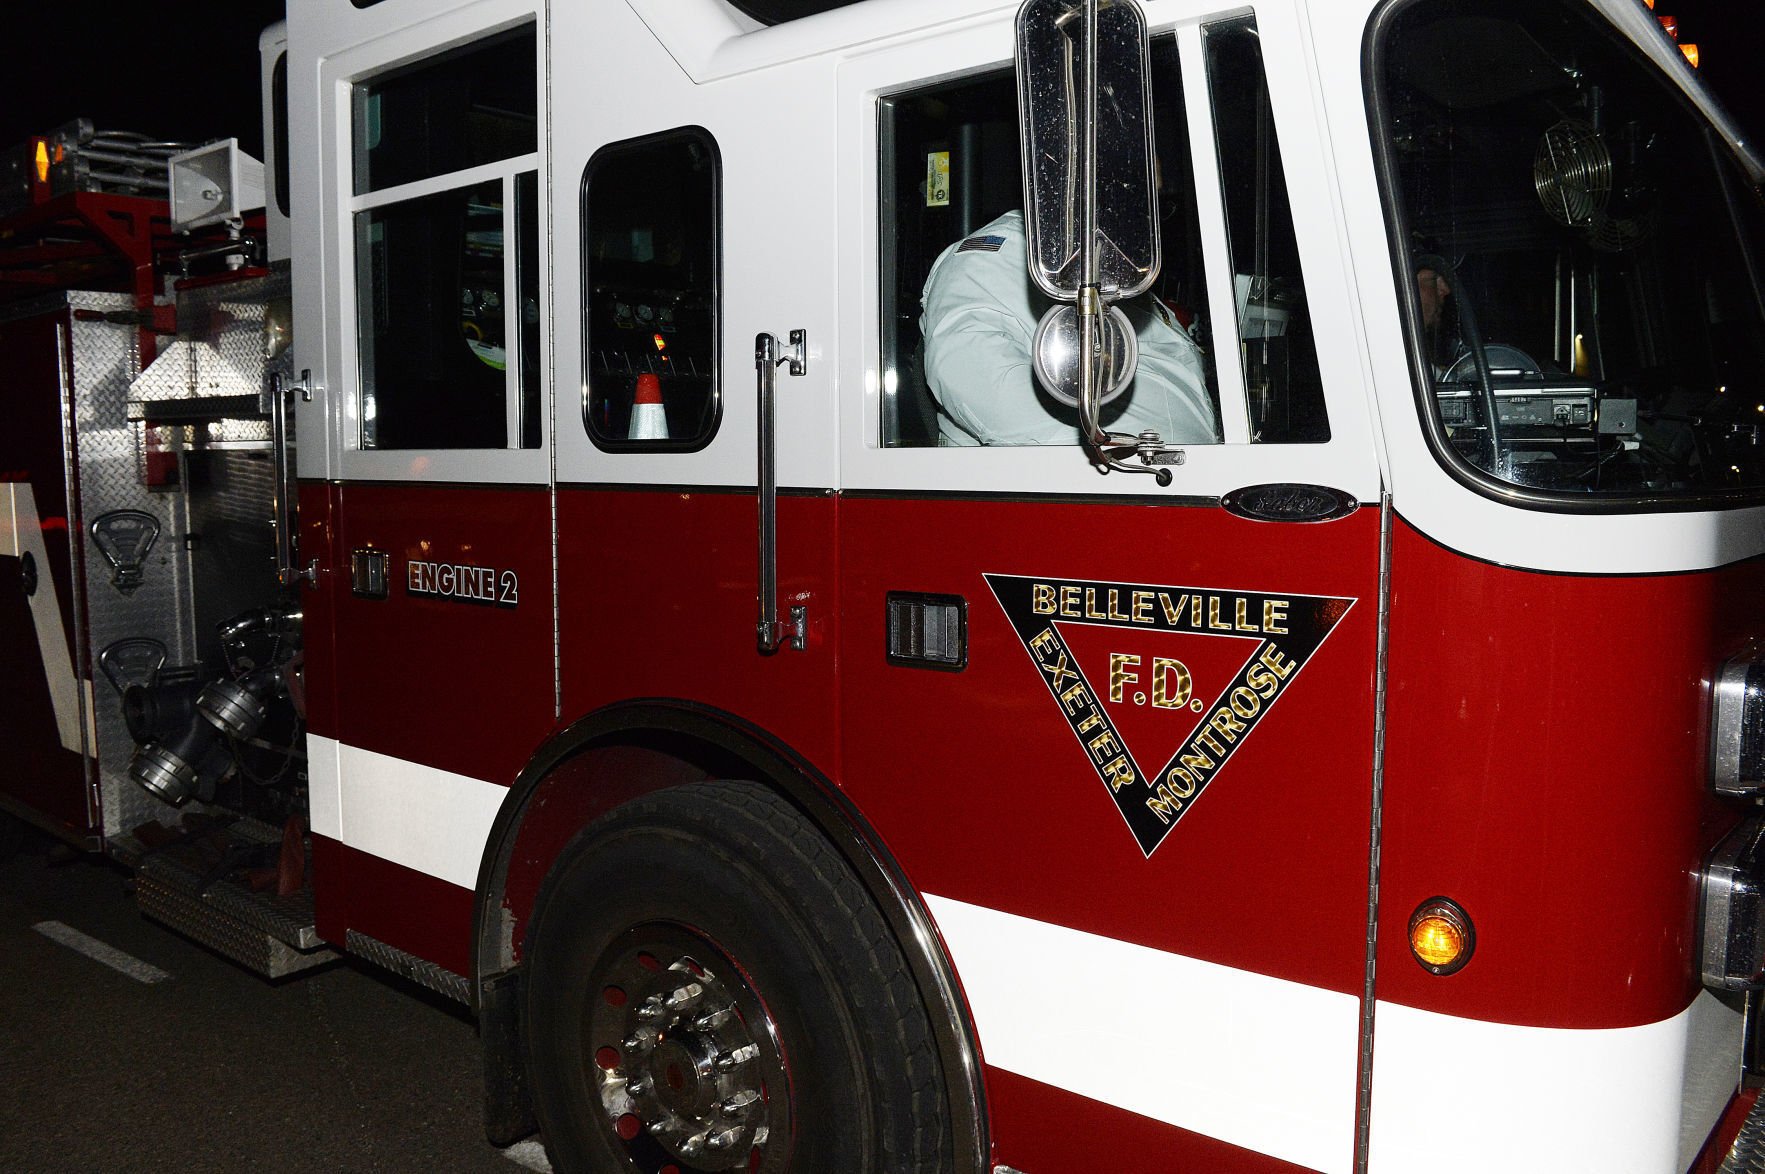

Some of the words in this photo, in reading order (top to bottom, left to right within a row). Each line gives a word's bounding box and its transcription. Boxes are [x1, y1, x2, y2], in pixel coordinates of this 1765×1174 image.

[408, 560, 495, 601] ENGINE
[499, 570, 518, 604] 2
[1032, 583, 1290, 635] BELLEVILLE
[1029, 627, 1136, 793] EXETER
[1109, 652, 1204, 713] F.D.
[1145, 642, 1298, 825] MONTROSE
